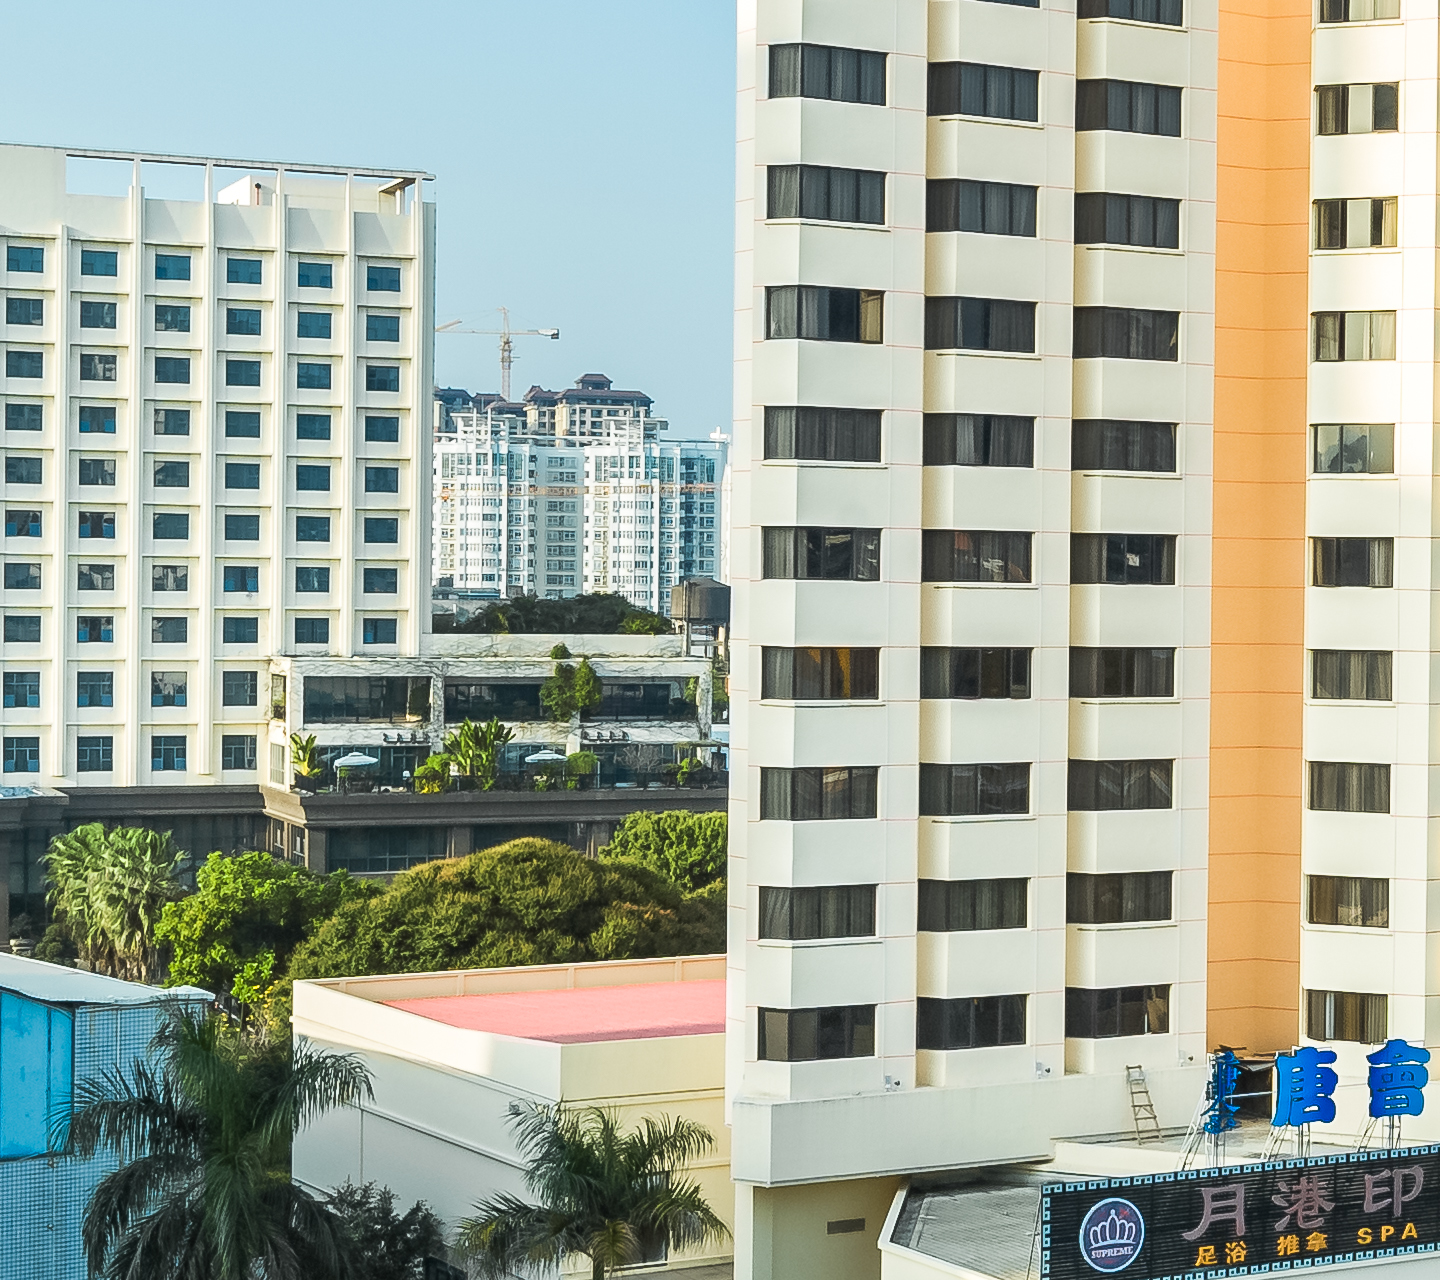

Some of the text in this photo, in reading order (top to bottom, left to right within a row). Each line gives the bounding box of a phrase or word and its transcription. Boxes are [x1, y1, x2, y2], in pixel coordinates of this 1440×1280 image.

[1091, 1245, 1134, 1259] SUPREME
[1194, 1240, 1247, 1267] 足浴
[1276, 1231, 1329, 1257] 推拿
[1357, 1222, 1419, 1245] SPA
